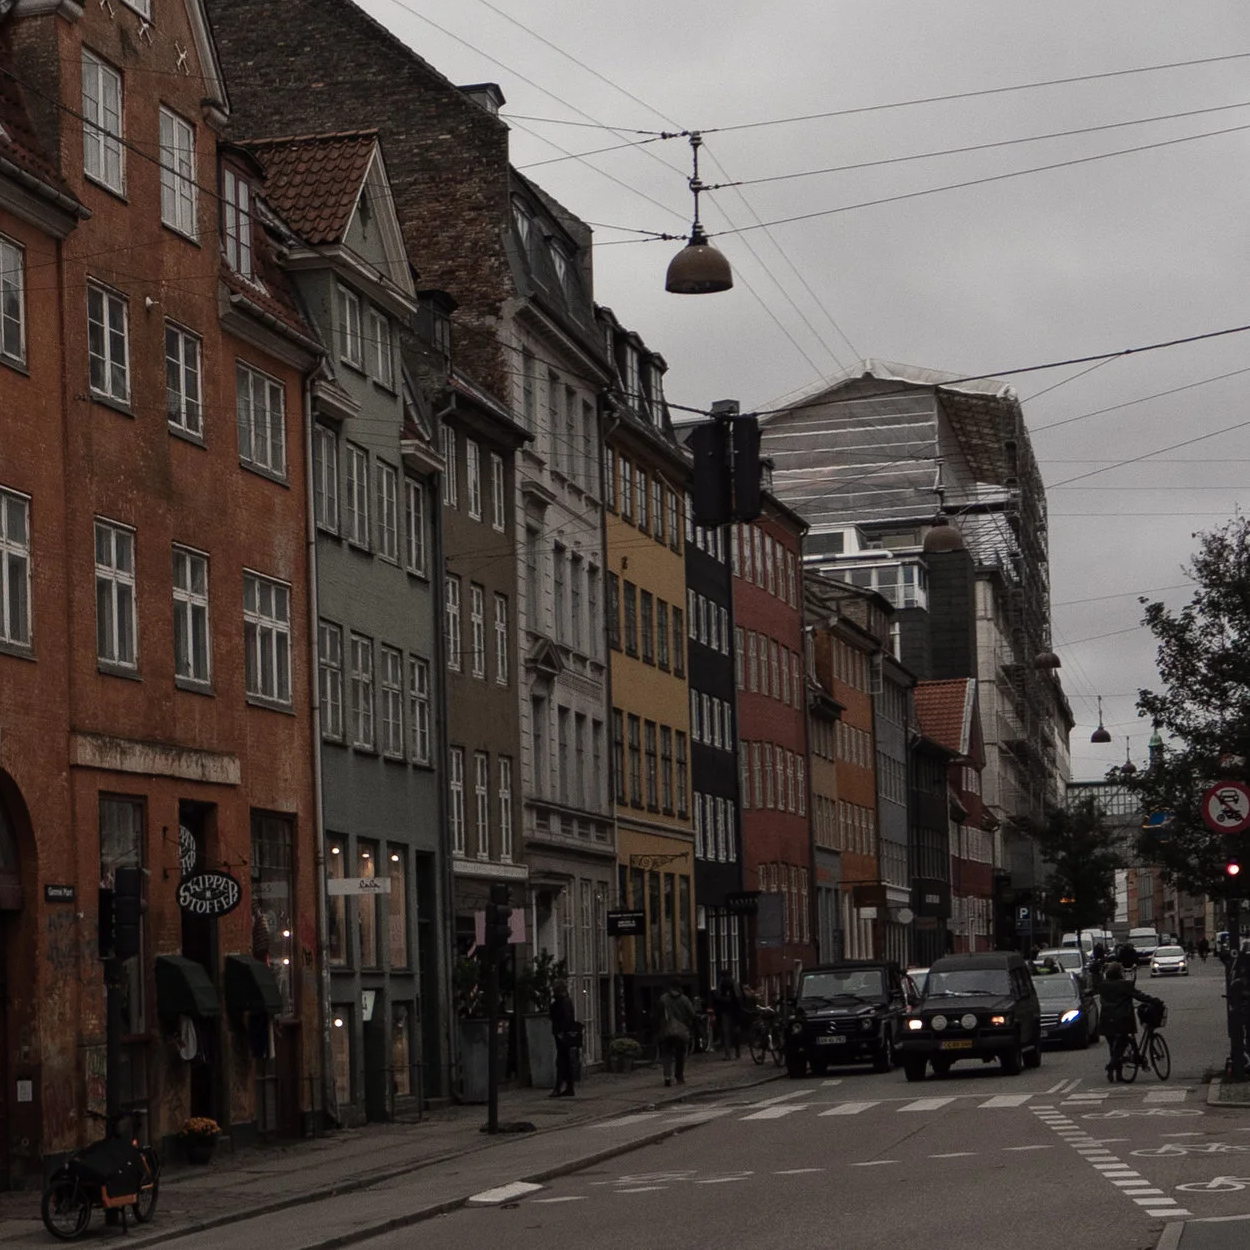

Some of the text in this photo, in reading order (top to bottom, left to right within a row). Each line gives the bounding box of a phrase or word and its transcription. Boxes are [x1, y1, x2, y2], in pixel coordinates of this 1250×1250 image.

[179, 874, 239, 900] SKIPPER
[179, 887, 239, 914] STOFFER
[1019, 907, 1029, 919] P
